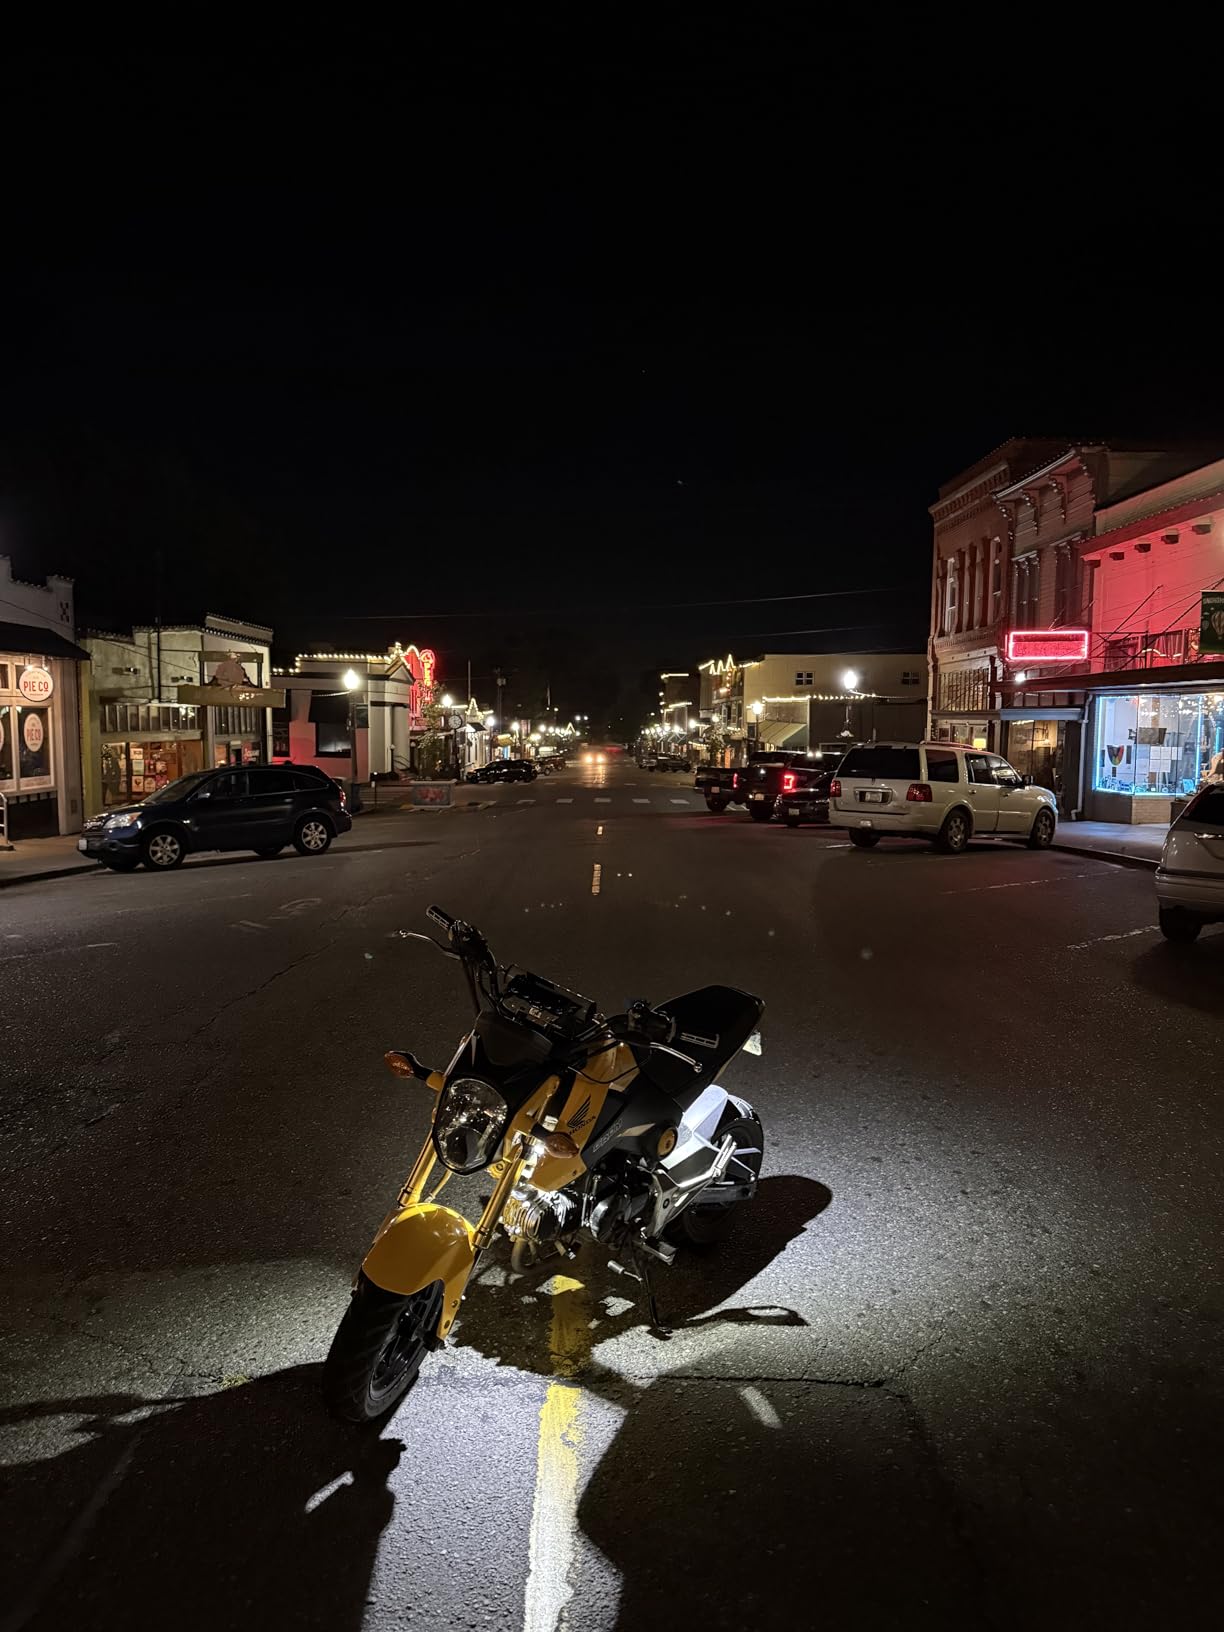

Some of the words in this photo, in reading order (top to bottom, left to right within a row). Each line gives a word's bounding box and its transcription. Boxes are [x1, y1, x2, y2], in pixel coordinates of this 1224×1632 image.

[23, 681, 36, 692] PIE
[38, 681, 49, 692] CO
[569, 1116, 596, 1135] HONDA
